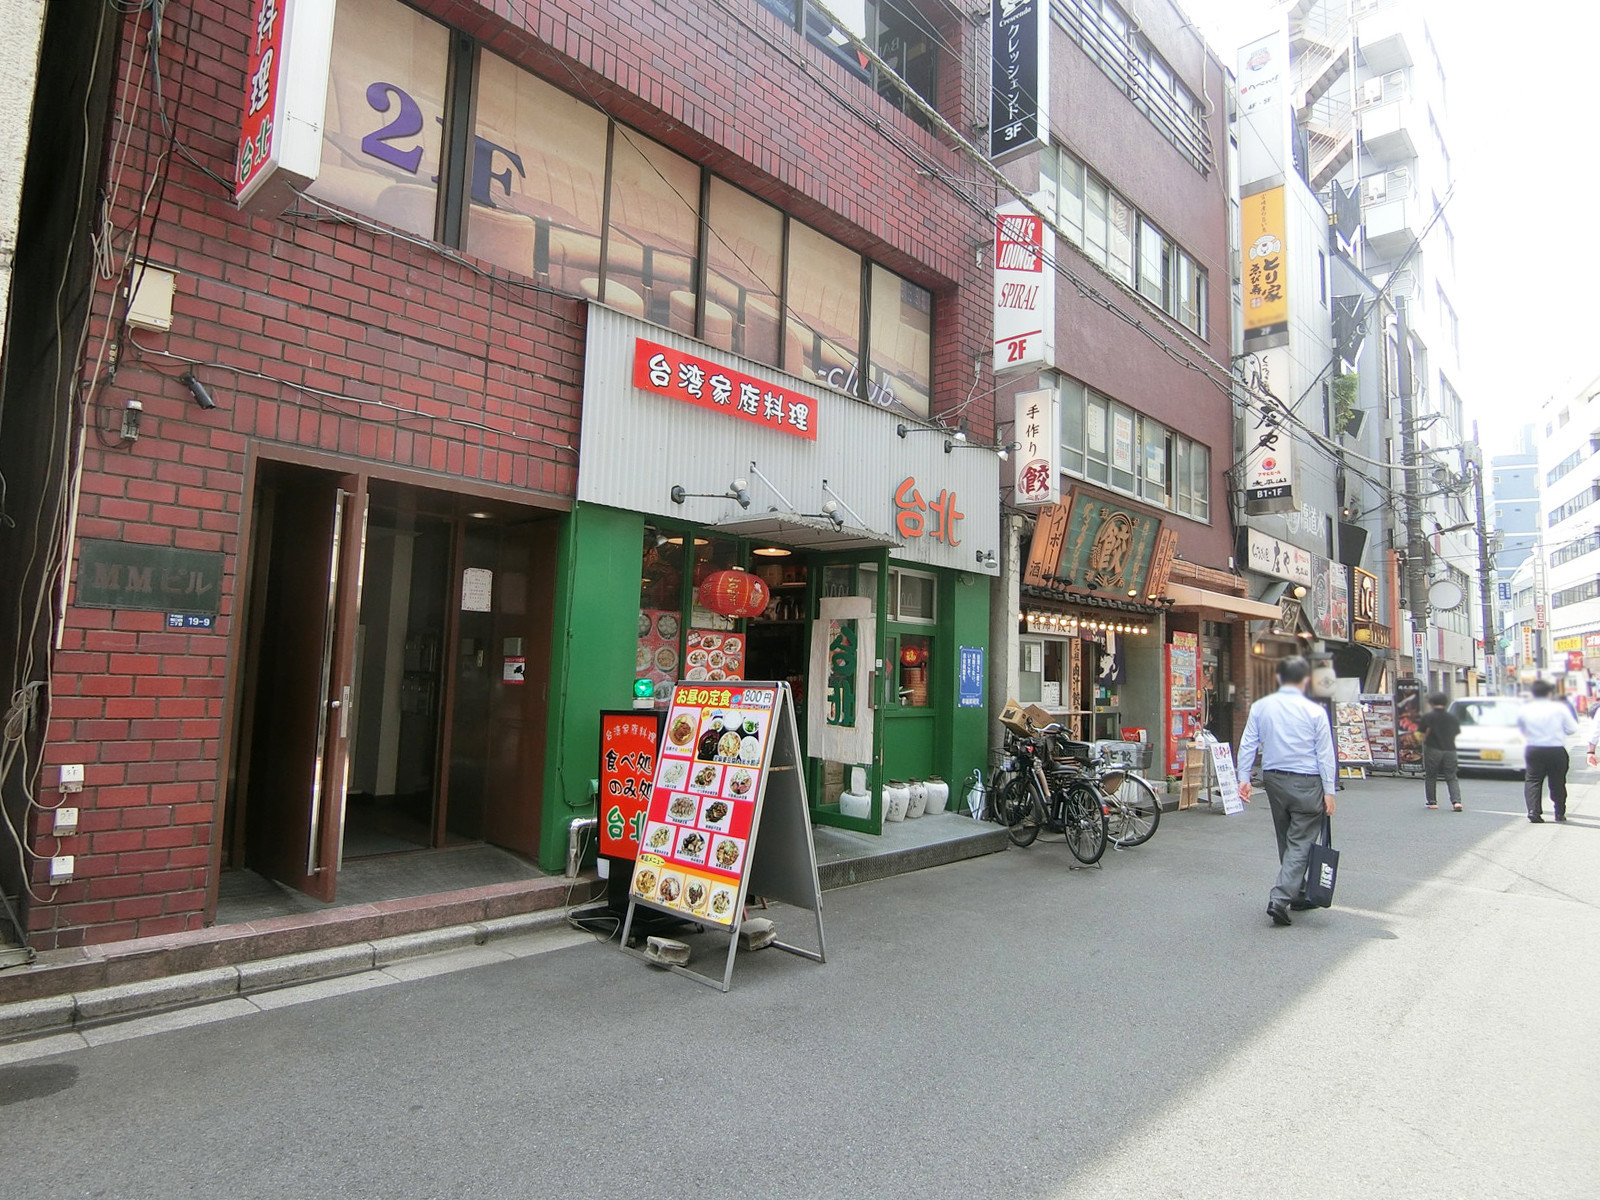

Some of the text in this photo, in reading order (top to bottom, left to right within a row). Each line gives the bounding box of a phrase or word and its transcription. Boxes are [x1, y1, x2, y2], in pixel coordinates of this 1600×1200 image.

[1007, 24, 1020, 120] クレッシェンド
[361, 81, 526, 209] 2F
[1004, 122, 1023, 142] 3F
[999, 243, 1039, 271] LOUNGE
[998, 282, 1040, 311] SPIRAL
[1007, 338, 1028, 363] 2F
[648, 352, 810, 432] 台湾家庭料理
[1026, 403, 1041, 458] 手作り
[1022, 464, 1050, 495] 餃
[895, 477, 965, 547] 台北
[188, 617, 210, 626] 19-9
[676, 688, 732, 706] お昼の定食
[744, 689, 772, 704] 800円
[605, 749, 652, 775] 食べ処
[609, 778, 653, 801] のみ処
